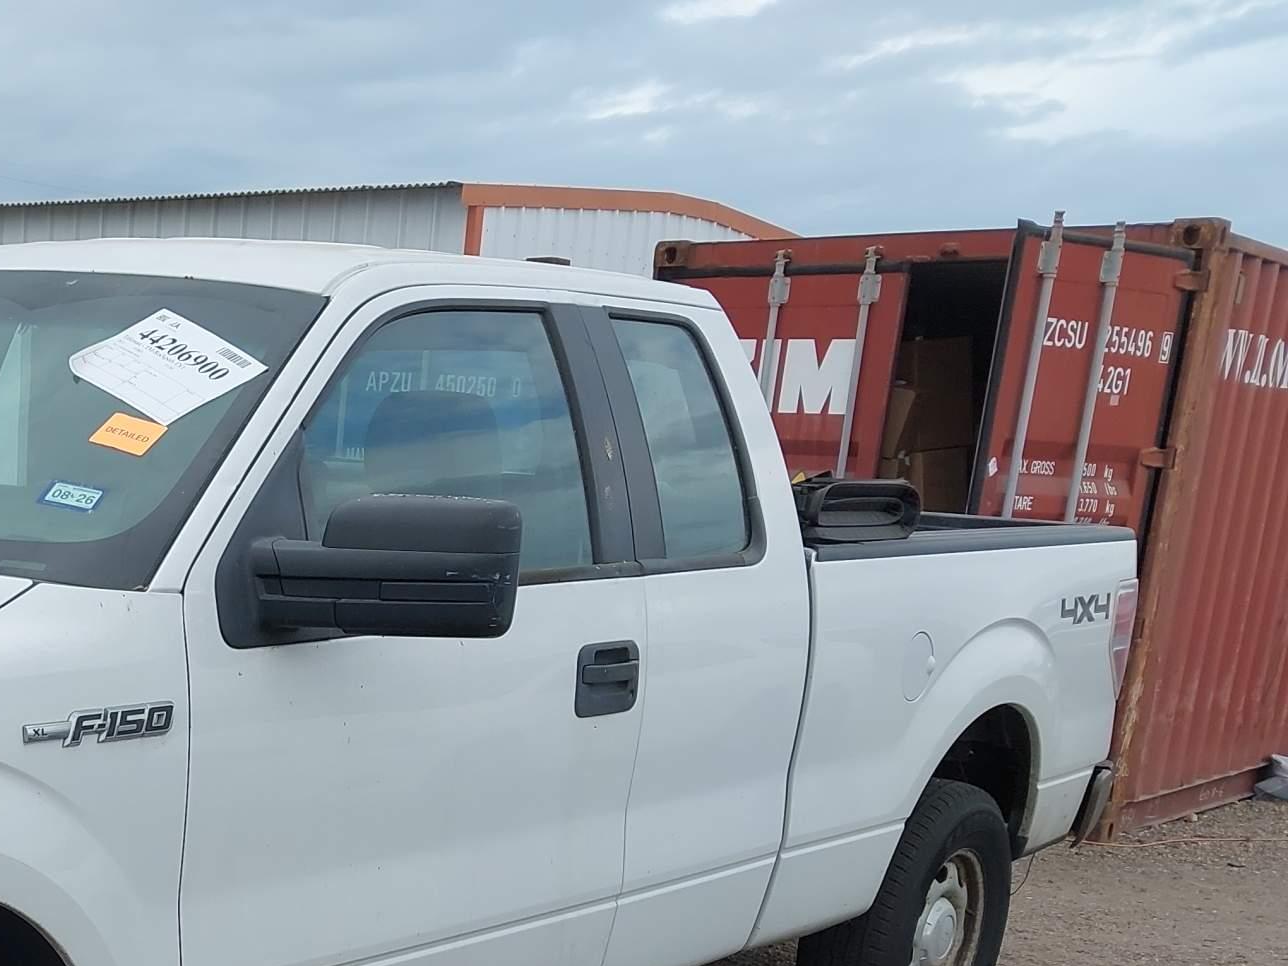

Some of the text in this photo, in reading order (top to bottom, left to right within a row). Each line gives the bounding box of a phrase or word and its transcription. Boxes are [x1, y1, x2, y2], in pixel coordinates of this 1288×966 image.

[1043, 317, 1089, 349] ZCSU
[1103, 326, 1154, 357] 255496
[139, 329, 230, 380] 44206900
[365, 371, 412, 393] APZU
[105, 426, 150, 443] DETAILED
[1030, 460, 1056, 476] GROSS
[1082, 462, 1097, 477] 500
[1103, 464, 1114, 482] kg
[1014, 496, 1034, 511] TARE
[1105, 500, 1115, 518] kg
[32, 701, 176, 748] XL F-150
